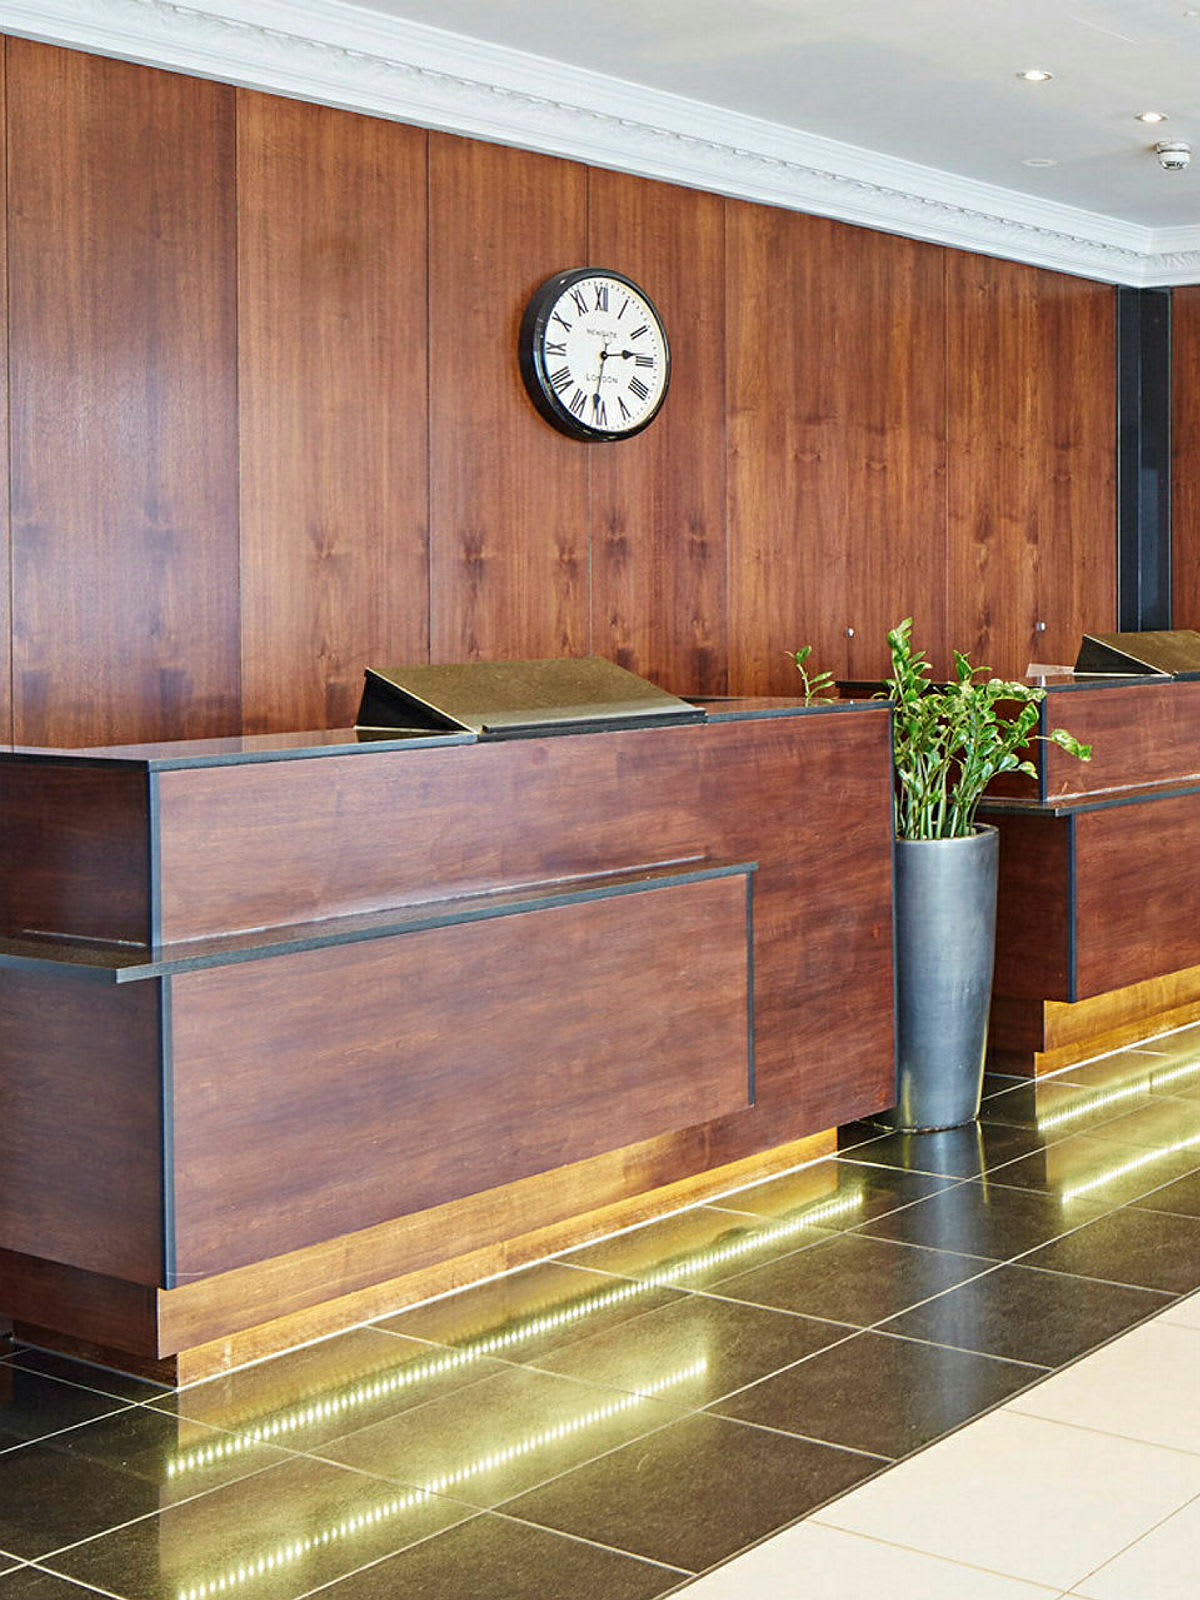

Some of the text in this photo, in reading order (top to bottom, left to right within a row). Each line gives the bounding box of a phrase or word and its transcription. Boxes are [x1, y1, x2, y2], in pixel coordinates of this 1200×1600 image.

[569, 289, 589, 317] XI
[594, 286, 609, 312] XII
[617, 299, 629, 320] I
[551, 311, 573, 333] X
[630, 325, 649, 340] II
[545, 341, 567, 356] IX
[635, 356, 654, 368] III
[550, 366, 575, 395] VIII
[569, 388, 588, 418] VII
[617, 396, 631, 421] V
